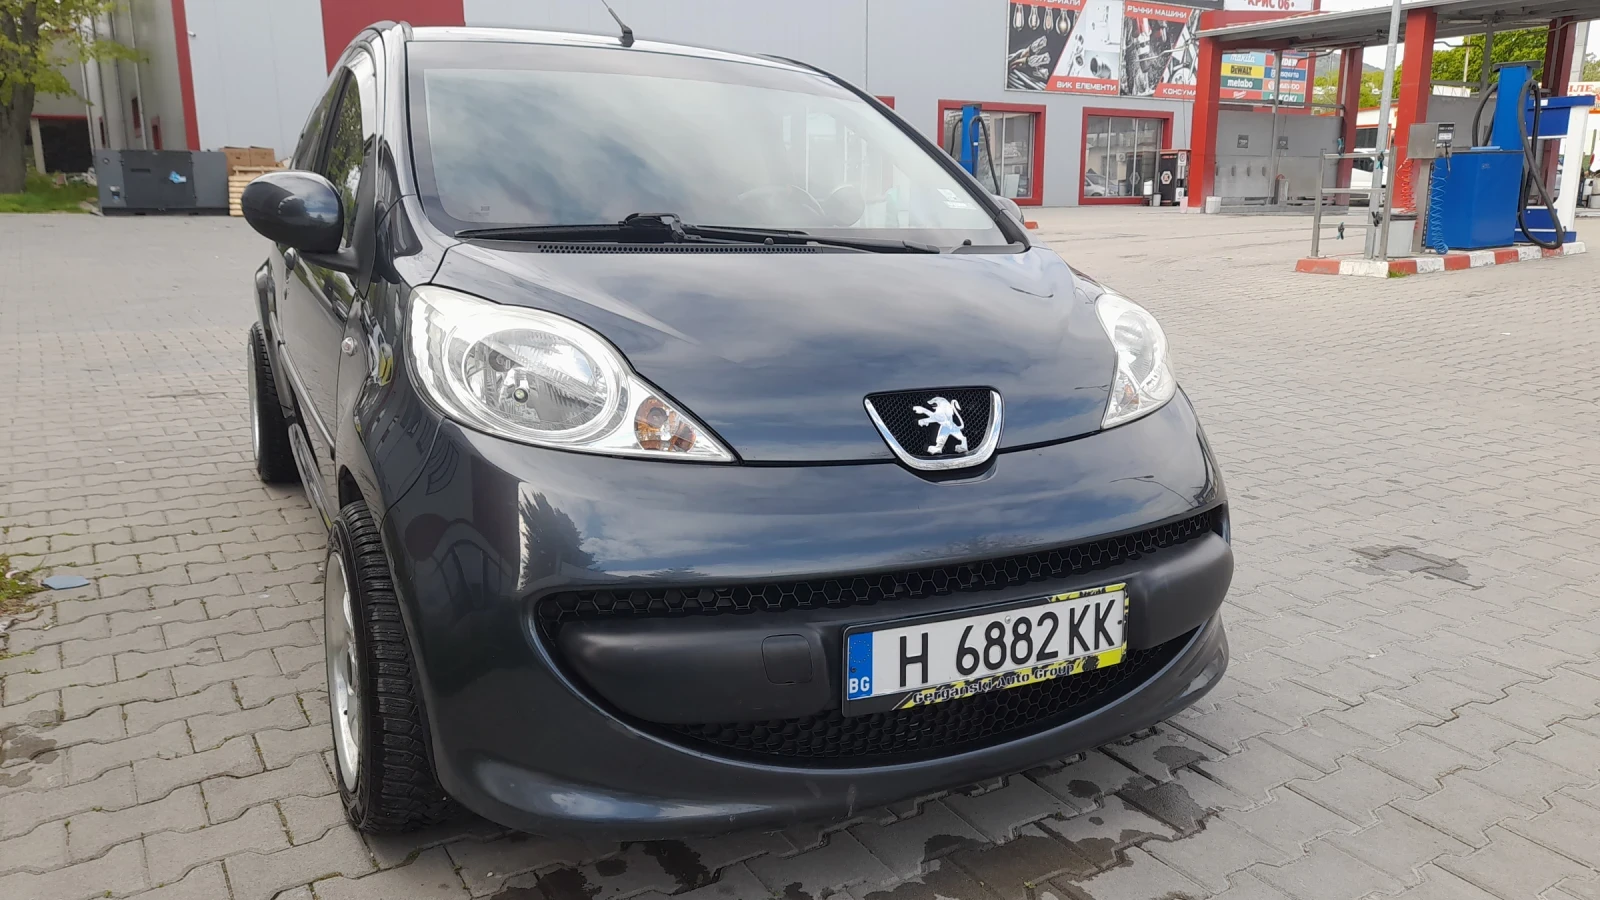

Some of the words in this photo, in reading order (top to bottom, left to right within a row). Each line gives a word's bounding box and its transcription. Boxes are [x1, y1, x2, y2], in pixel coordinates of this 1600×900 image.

[1127, 5, 1153, 14] РЪЧНИ
[1154, 9, 1187, 19] МАШИНИ
[1056, 81, 1073, 89] ВИК
[1075, 82, 1117, 92] ЕЛЕМЕНТИ
[1227, 79, 1254, 89] metabo
[899, 632, 929, 687] H
[849, 676, 870, 694] BG
[912, 679, 994, 705] Gerganski
[996, 671, 1030, 689] Auto
[1034, 663, 1075, 683] Group
